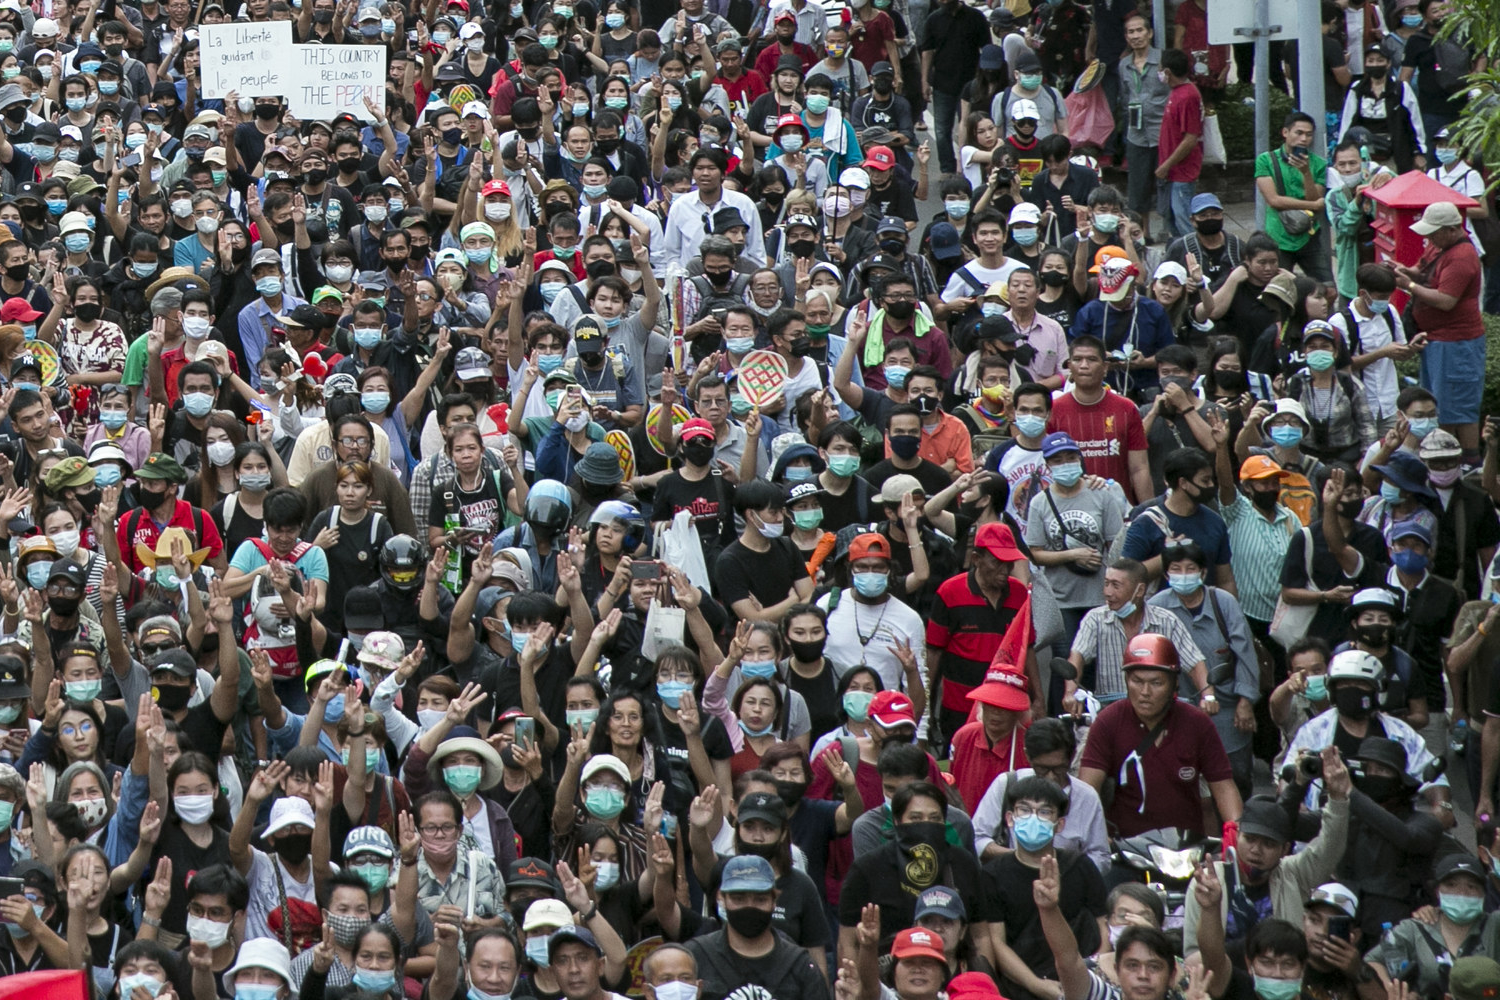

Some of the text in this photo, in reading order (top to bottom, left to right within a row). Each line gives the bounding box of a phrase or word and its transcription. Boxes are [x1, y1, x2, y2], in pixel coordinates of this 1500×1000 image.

[208, 27, 272, 47] La Liberté
[301, 48, 380, 65] THIS COUNTRY
[217, 69, 279, 90] le peuple
[321, 70, 373, 81] BELONGS TO
[301, 86, 332, 105] THE
[1075, 438, 1109, 448] tandard
[348, 826, 388, 846] GIRL
